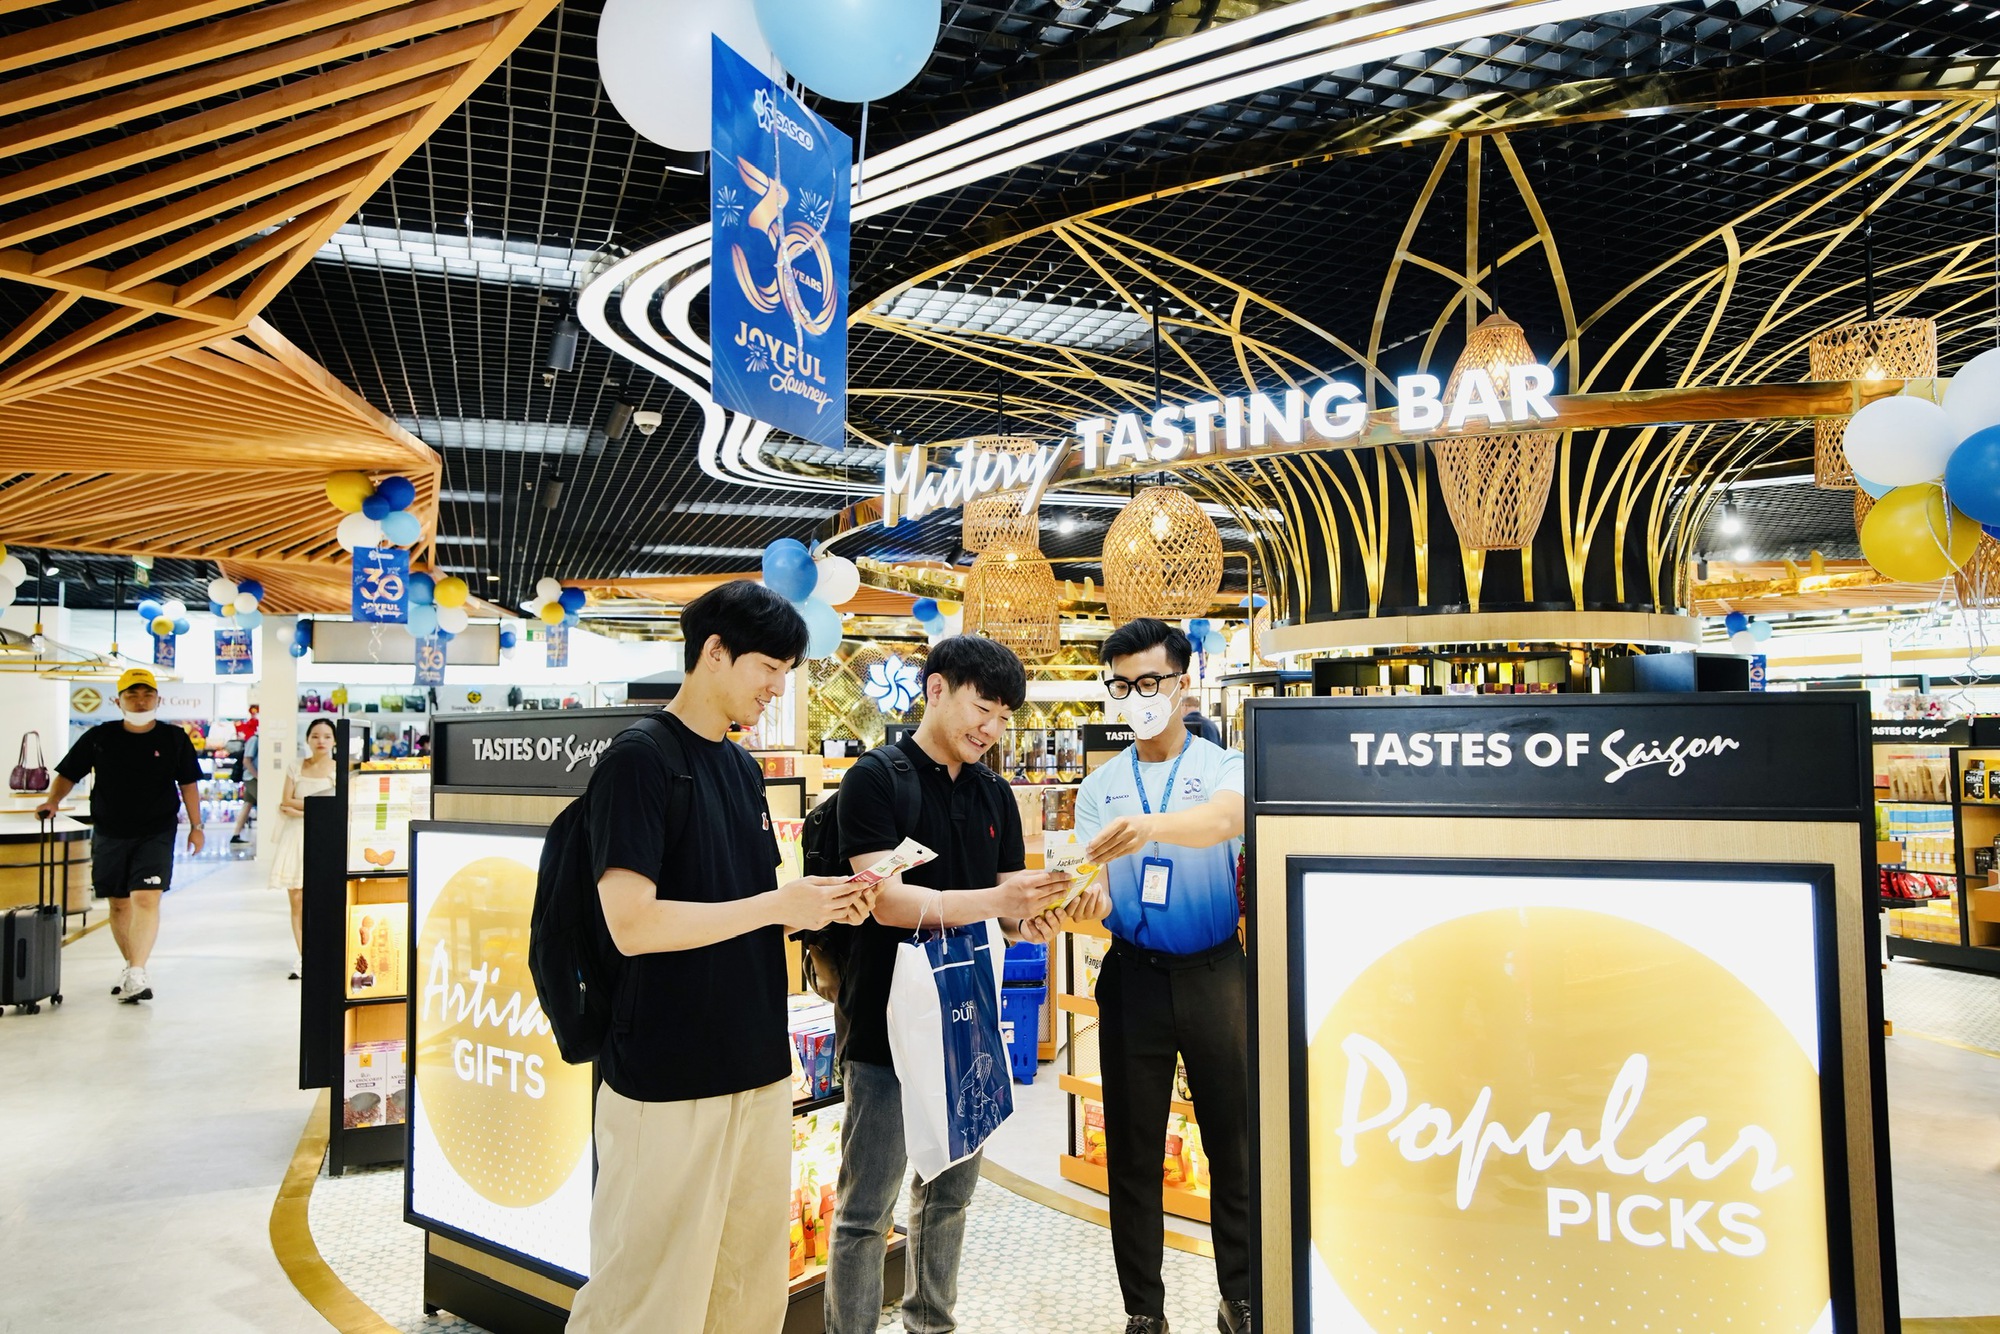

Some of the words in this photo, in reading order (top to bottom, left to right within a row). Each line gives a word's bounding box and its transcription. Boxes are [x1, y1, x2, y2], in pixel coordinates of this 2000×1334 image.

[776, 111, 813, 150] SASCO
[792, 267, 823, 294] YEARS
[734, 320, 827, 385] JOYFUL
[770, 362, 834, 415] Journey
[883, 435, 1074, 529] Mastery
[1076, 381, 1368, 470] TASTING
[1397, 363, 1560, 433] BAR
[360, 567, 405, 601] 30
[170, 696, 201, 708] Corp
[472, 737, 534, 761] TASTES
[536, 737, 563, 761] OF
[565, 734, 612, 772] Saigo
[1105, 731, 1136, 741] TASTE
[1902, 726, 1918, 736] OF
[1350, 732, 1512, 767] TASTES
[1524, 732, 1590, 767] OF
[1601, 728, 1740, 783] Saigon
[423, 938, 557, 1043] Artisa
[952, 1005, 975, 1024] DUT
[454, 1039, 546, 1100] GIFTS
[1335, 1032, 1794, 1210] Popular
[1546, 1186, 1767, 1258] PICKS
